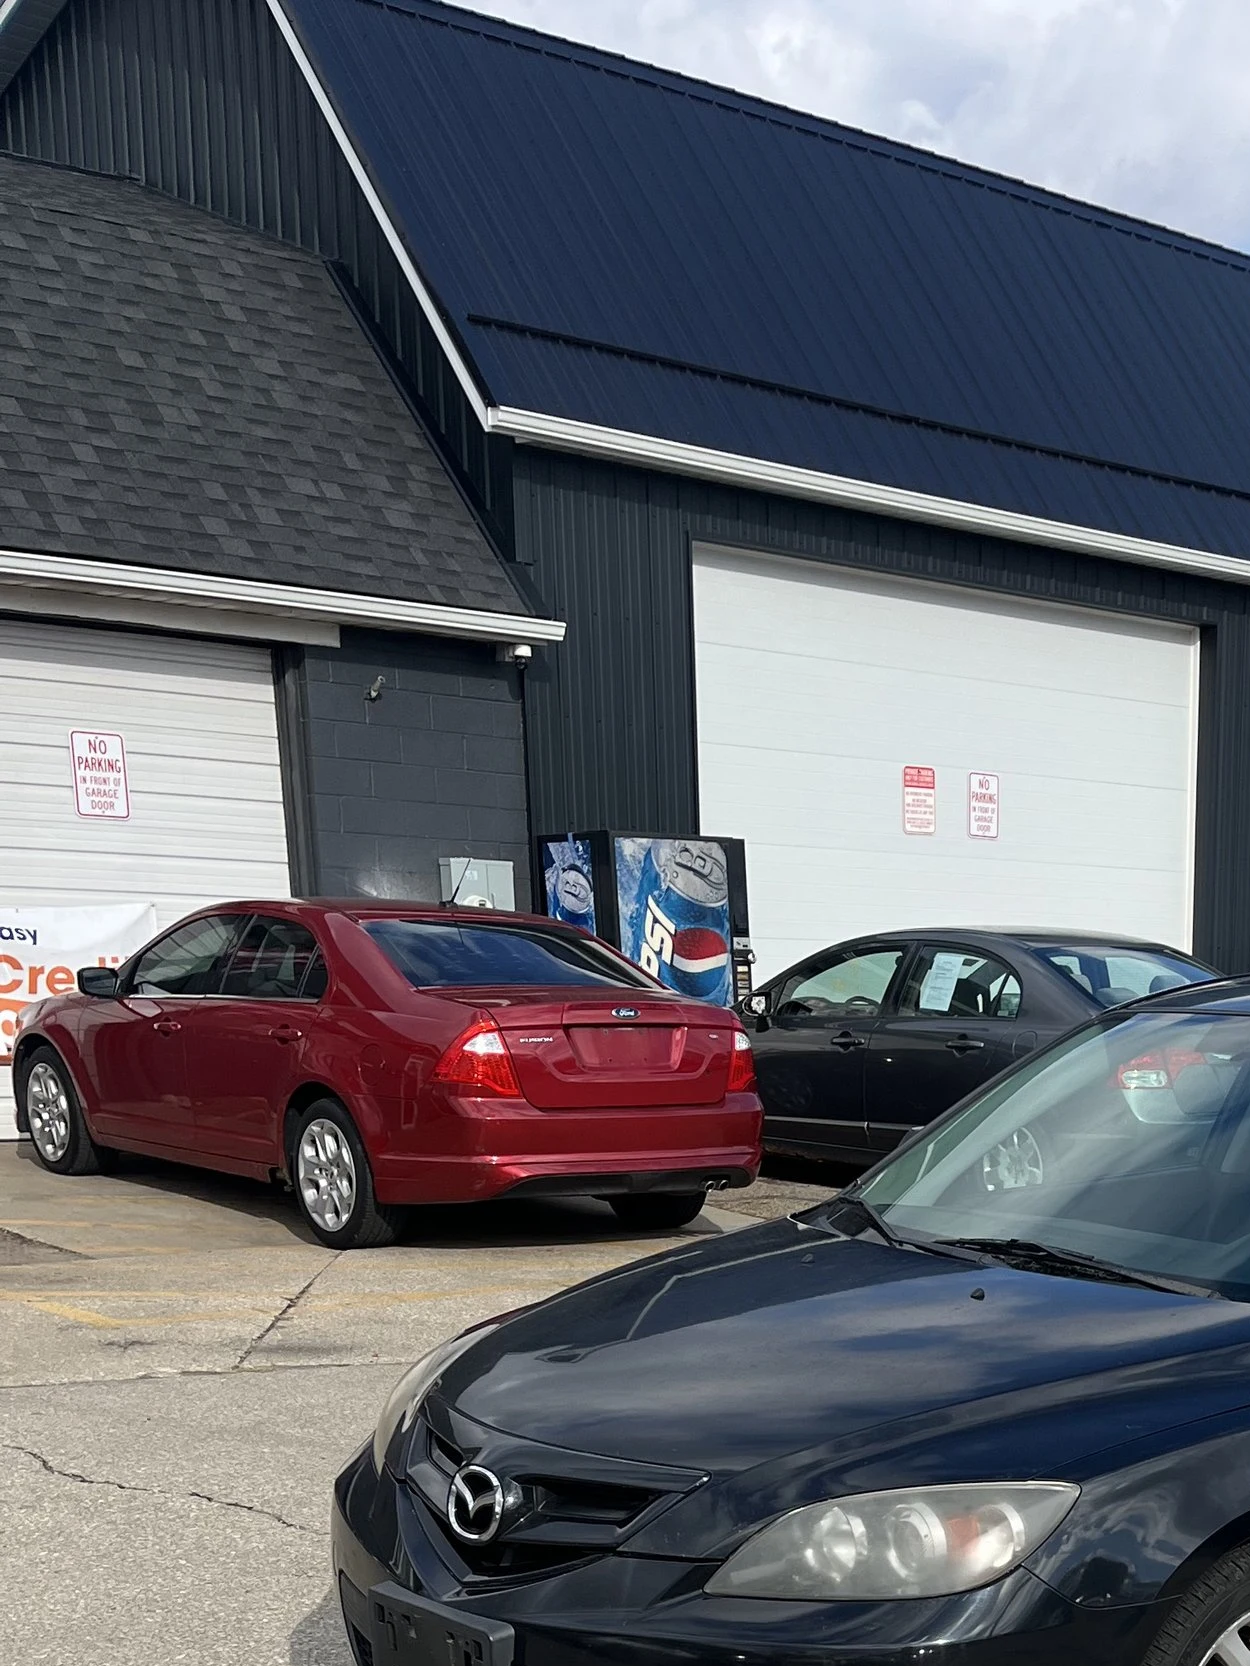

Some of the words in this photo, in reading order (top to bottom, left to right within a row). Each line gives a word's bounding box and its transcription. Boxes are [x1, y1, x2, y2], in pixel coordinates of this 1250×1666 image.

[88, 739, 107, 754] NO
[77, 756, 121, 773] PARKING
[79, 775, 87, 784] IN
[90, 776, 110, 786] FRONT
[113, 777, 121, 787] OF
[978, 779, 990, 791] NO
[85, 787, 119, 799] GARAGE
[971, 791, 997, 805] PARKING
[91, 800, 115, 810] DOOR
[974, 815, 993, 823] GARAGE
[976, 824, 991, 832] DOOR
